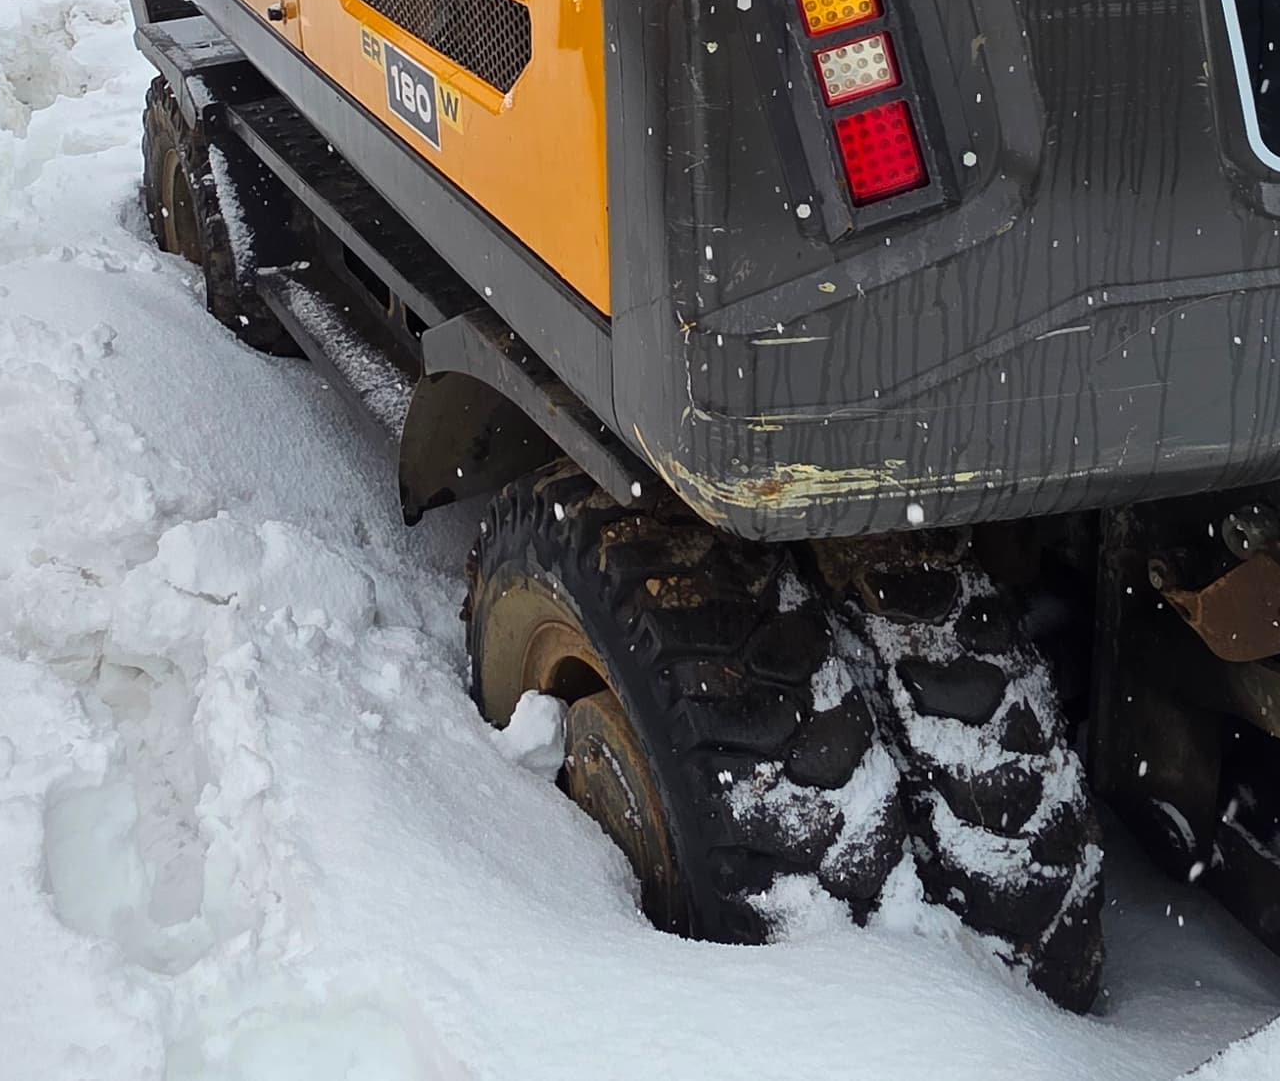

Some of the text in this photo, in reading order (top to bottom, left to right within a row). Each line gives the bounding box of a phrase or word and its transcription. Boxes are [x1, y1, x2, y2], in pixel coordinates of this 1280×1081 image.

[360, 29, 460, 124] ER 180 W
